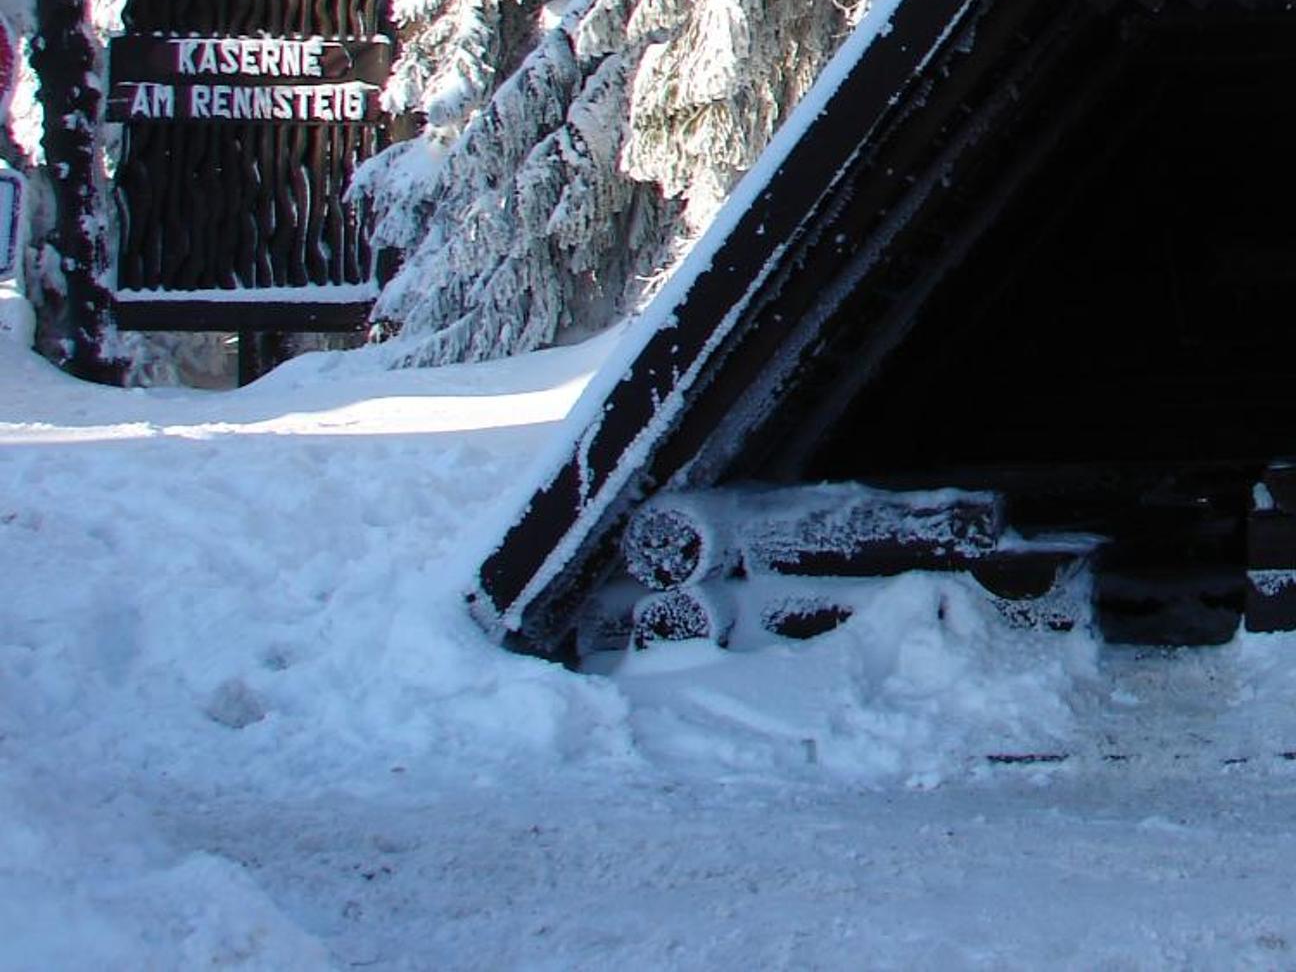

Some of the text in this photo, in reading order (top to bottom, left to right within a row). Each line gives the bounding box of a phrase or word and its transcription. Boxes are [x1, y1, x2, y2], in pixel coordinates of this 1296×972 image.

[177, 38, 323, 77] KASERNE
[130, 84, 366, 121] AM RENNSTEIG
